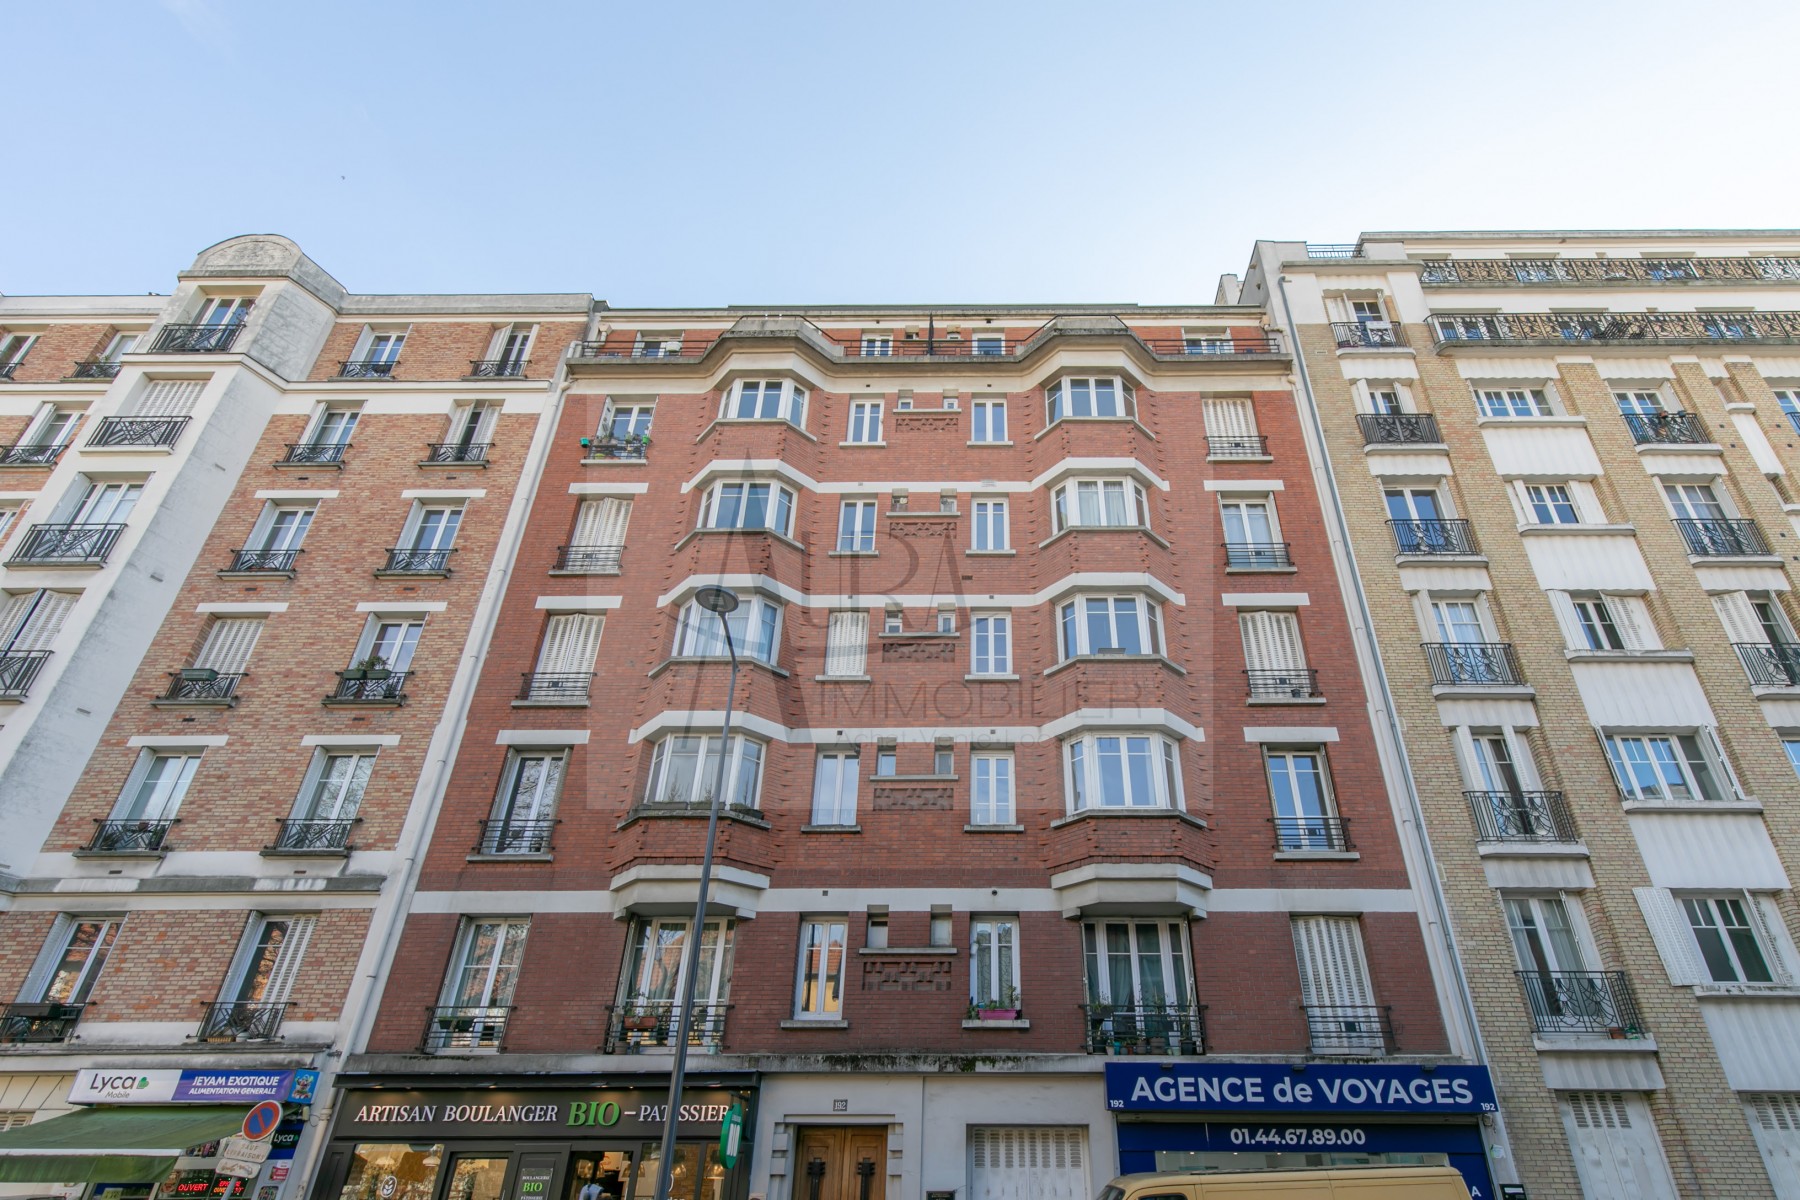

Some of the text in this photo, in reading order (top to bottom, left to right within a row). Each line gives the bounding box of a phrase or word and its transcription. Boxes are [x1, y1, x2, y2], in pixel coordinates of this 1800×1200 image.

[90, 1073, 137, 1093] Lyca
[192, 1076, 280, 1087] JEYAM EXOTIQUE
[105, 1091, 131, 1099] Mobile
[189, 1087, 240, 1095] ALIMENTATION
[1131, 1076, 1473, 1105] AGENCE de VOYAGES
[835, 1101, 847, 1110] 192
[1110, 1100, 1125, 1108] 192
[1481, 1103, 1496, 1111] 192
[354, 1105, 437, 1122] ARTISAN
[442, 1105, 558, 1122] BOULANGER
[566, 1101, 621, 1127] BIO
[638, 1105, 730, 1122] PATSSIER
[274, 1133, 295, 1143] Lyca
[1230, 1128, 1366, 1145] 01.44.67.89.00
[178, 1183, 208, 1192] OUVERT
[523, 1182, 543, 1192] BIO
